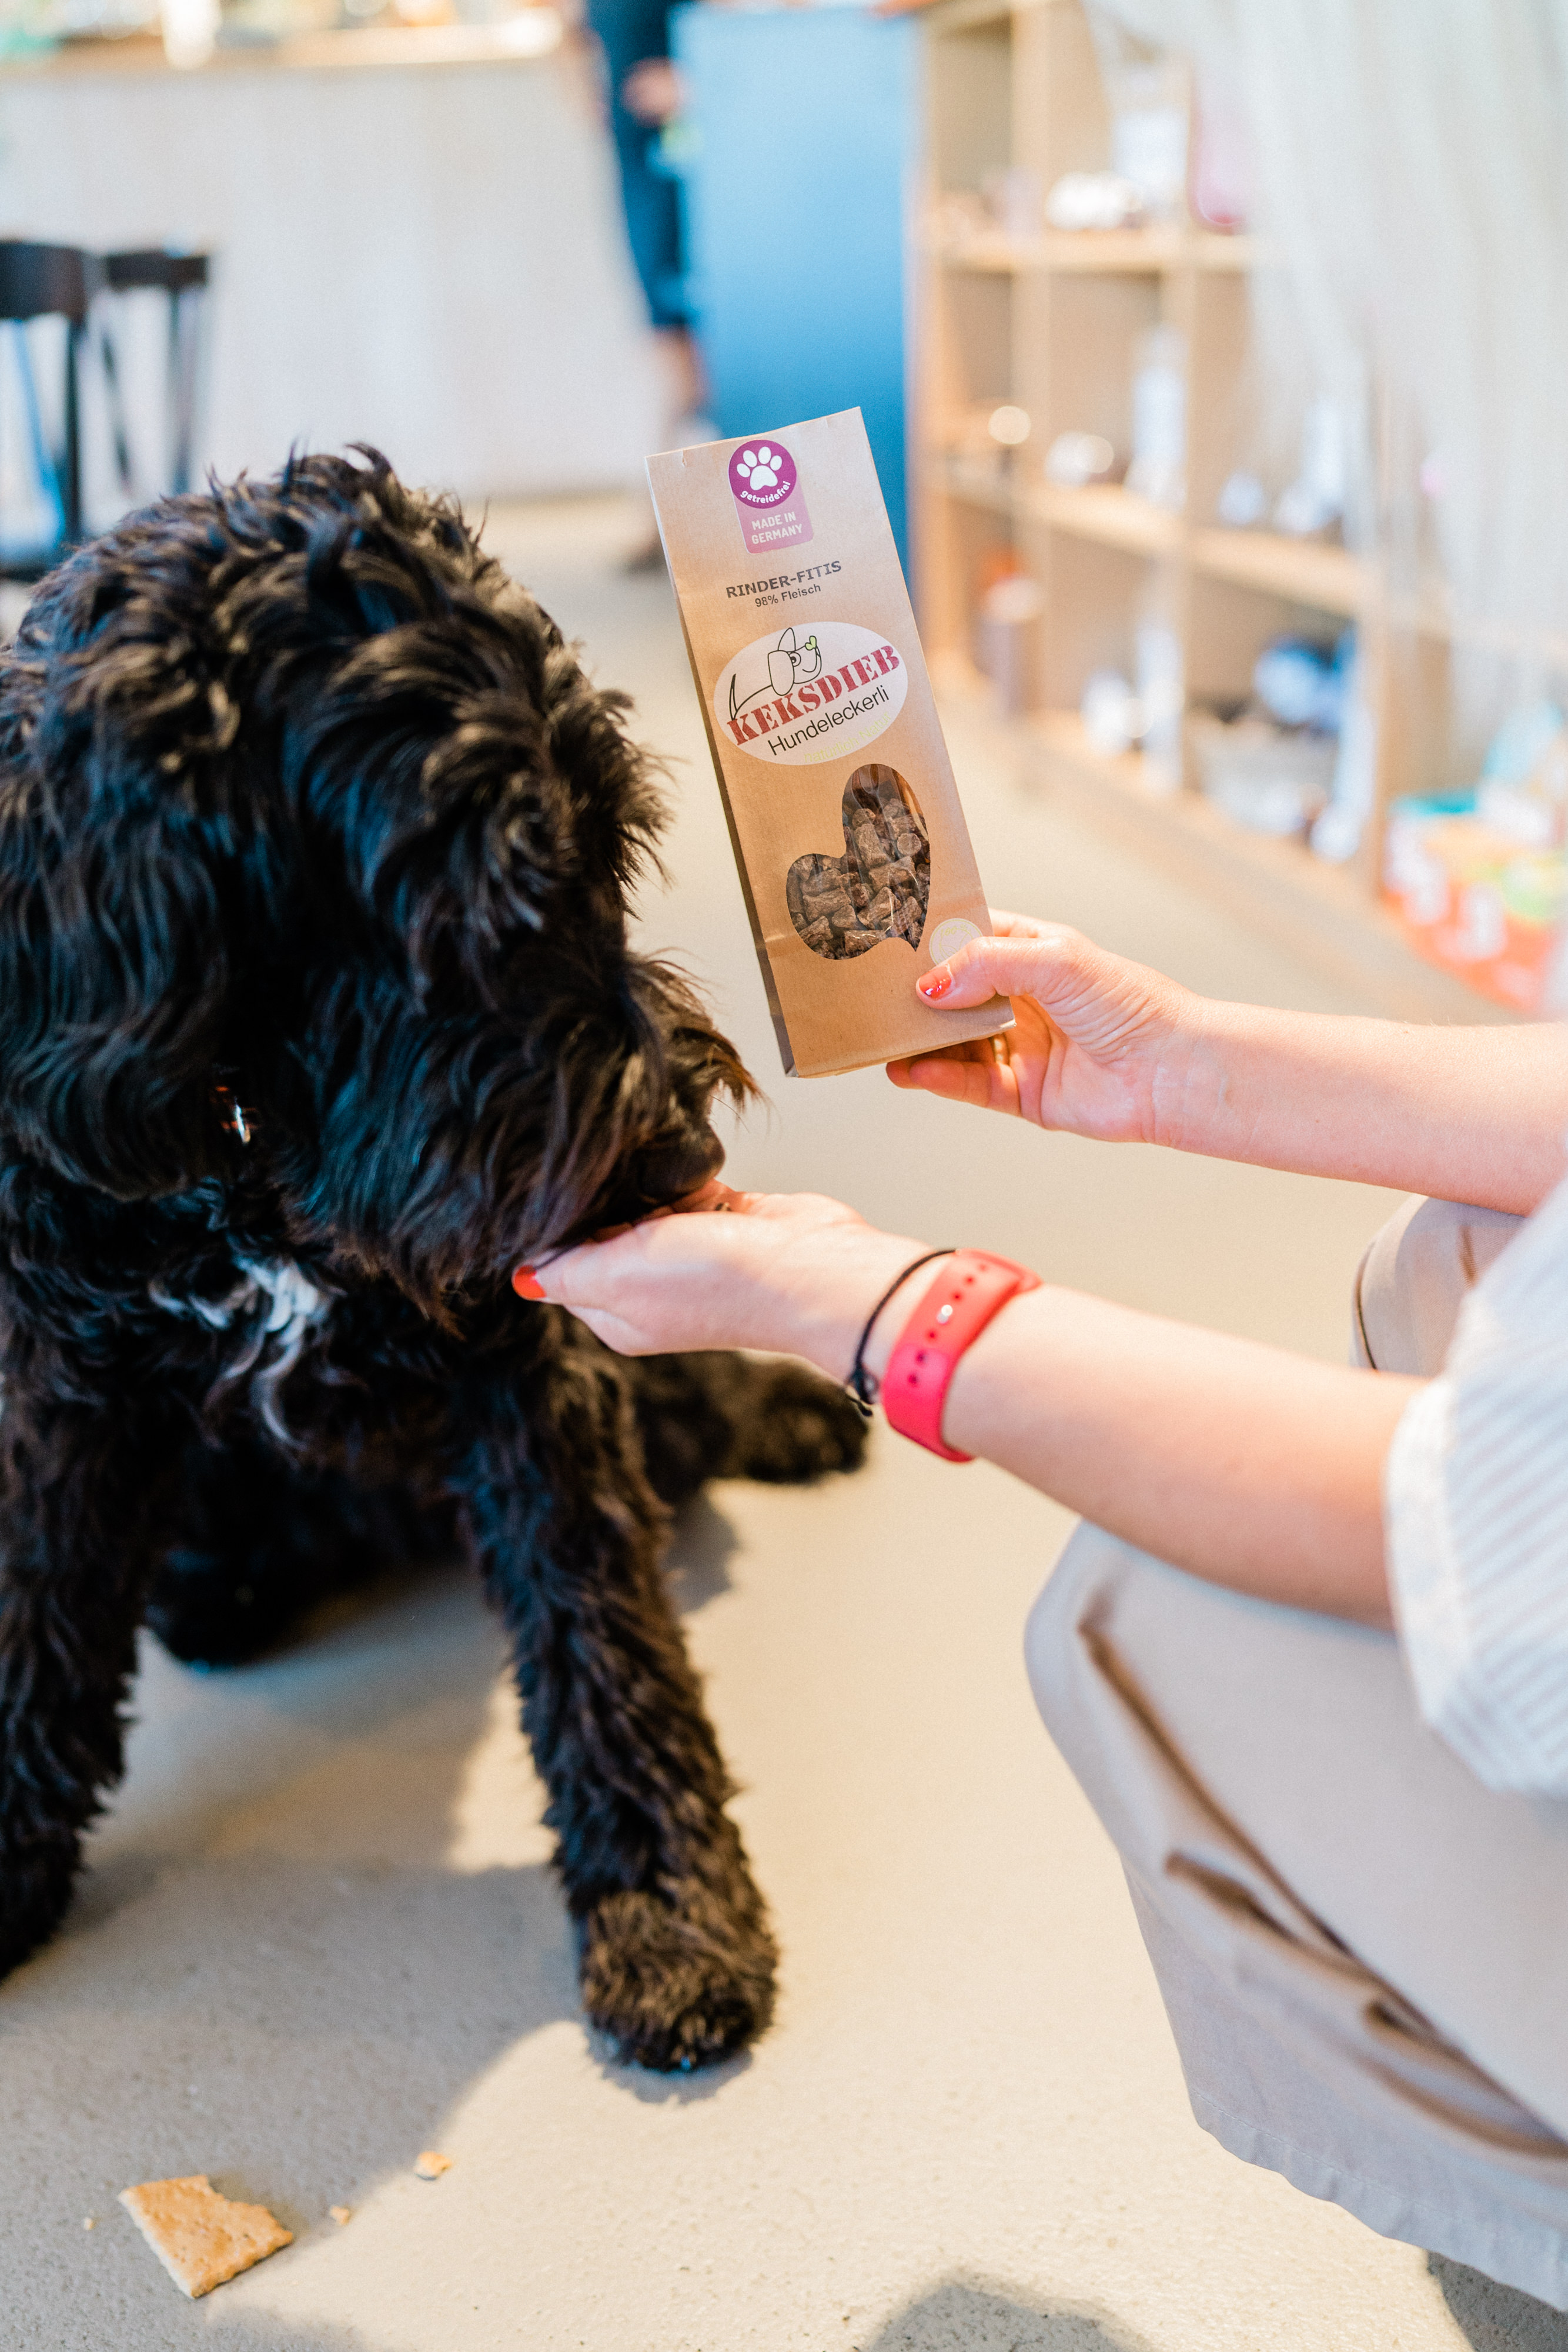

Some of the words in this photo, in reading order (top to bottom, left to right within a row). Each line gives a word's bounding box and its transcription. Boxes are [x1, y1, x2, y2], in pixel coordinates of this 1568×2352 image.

[740, 481, 790, 503] getreidefrei
[751, 514, 783, 530] MADE
[784, 512, 796, 523] IN
[751, 523, 803, 544] GERMANY
[726, 560, 841, 598] RINDER-FITIS
[755, 594, 778, 607] 98%
[781, 584, 821, 601] Fleisch
[727, 645, 900, 746] KEKSDIEB
[767, 685, 890, 756] Hundeleckerli
[804, 737, 860, 763] natürlich
[858, 712, 891, 741] Natur
